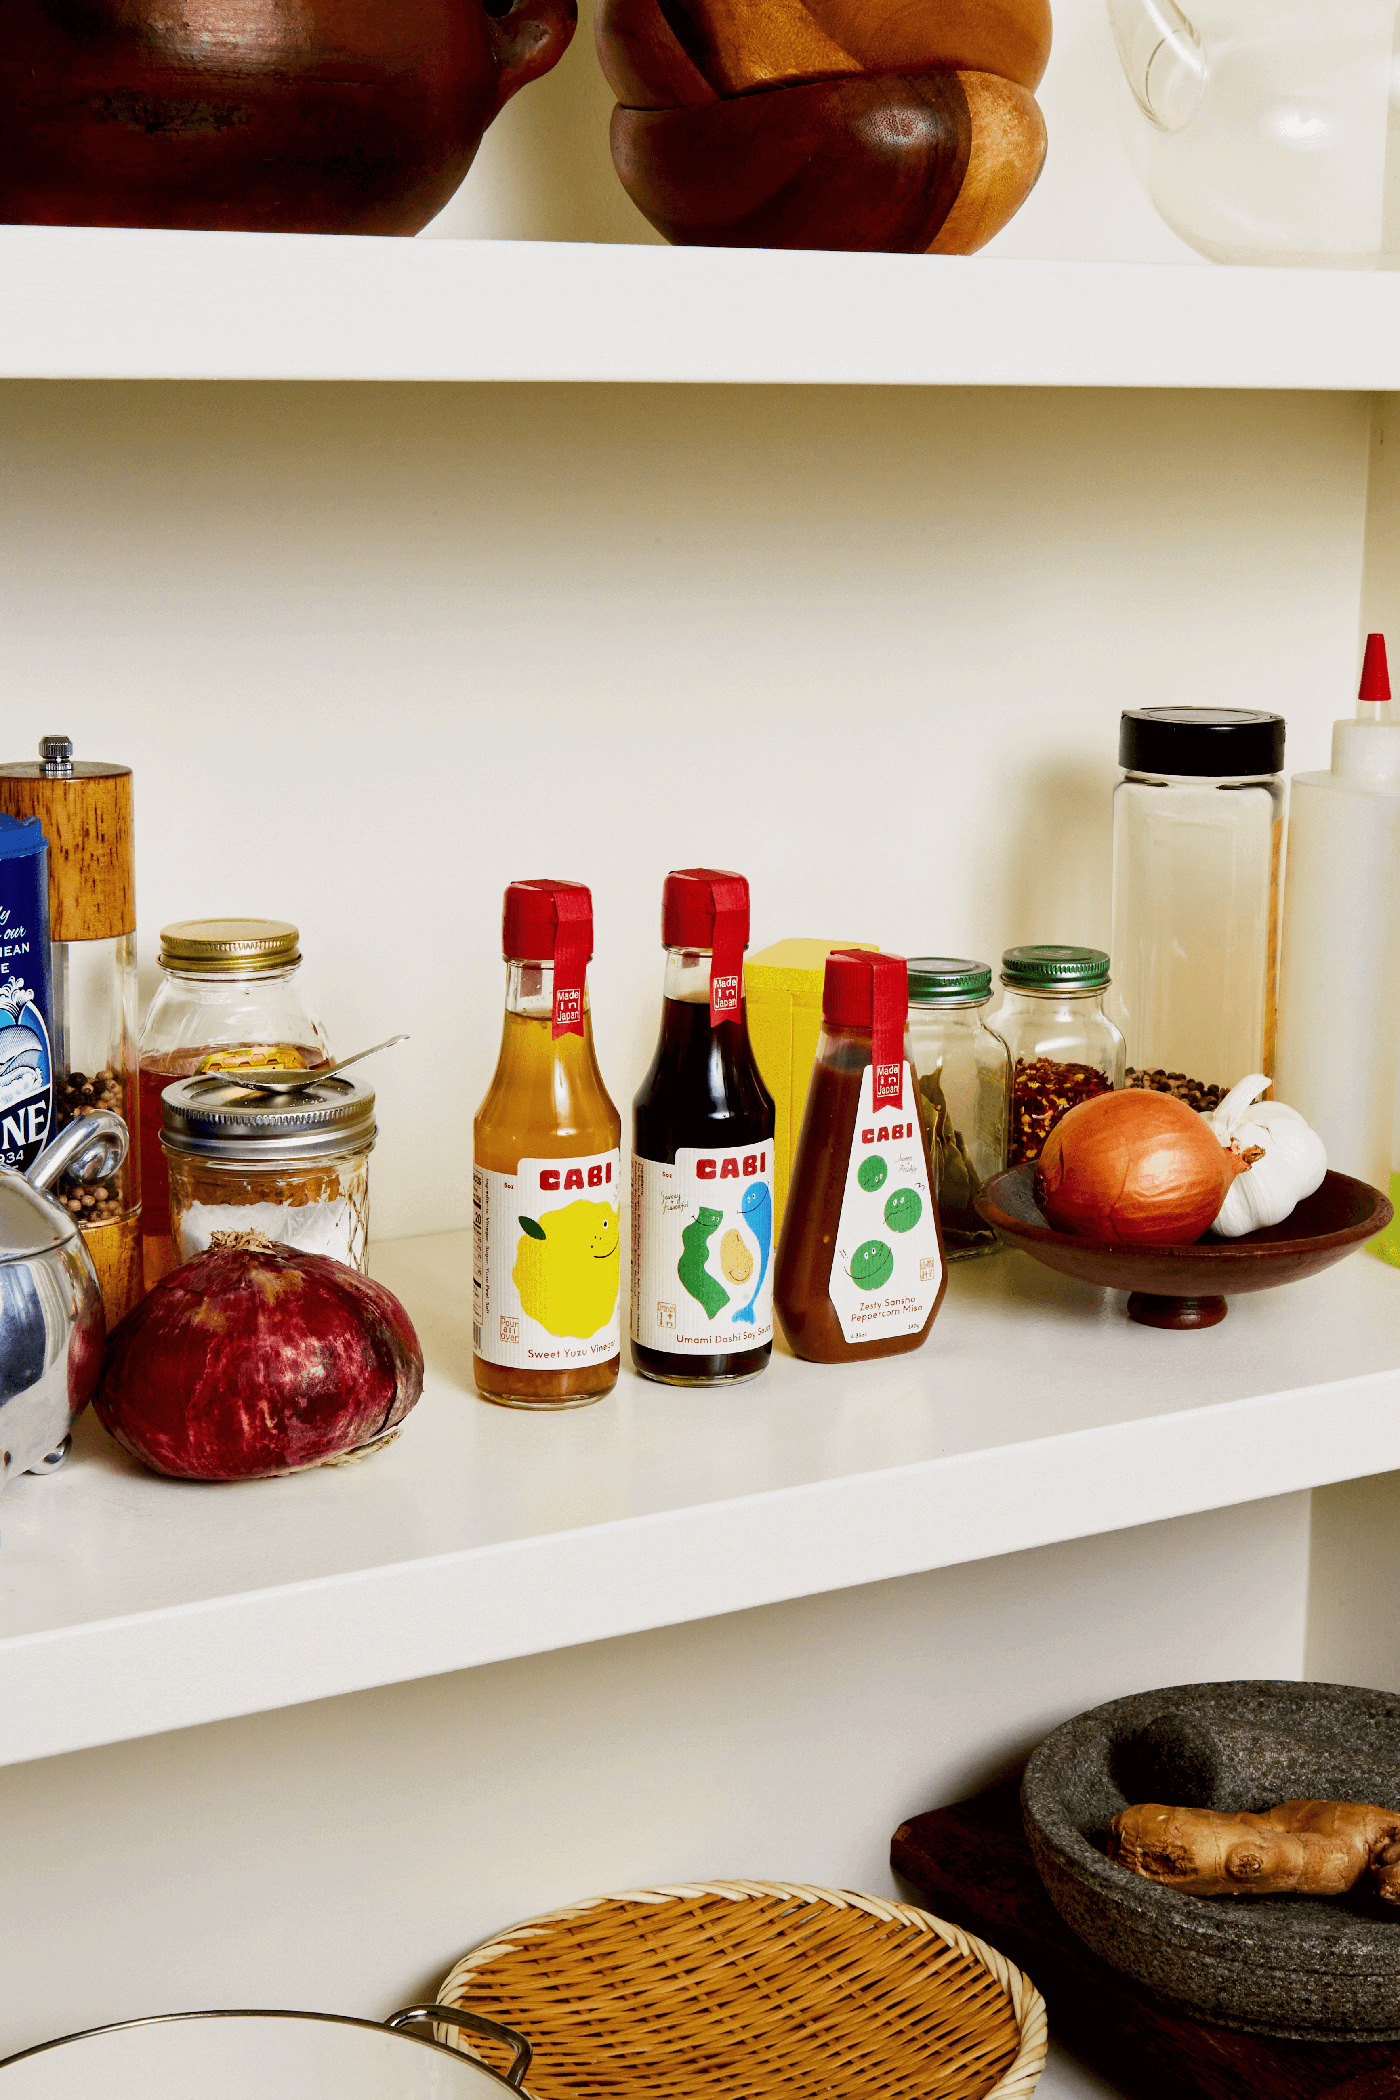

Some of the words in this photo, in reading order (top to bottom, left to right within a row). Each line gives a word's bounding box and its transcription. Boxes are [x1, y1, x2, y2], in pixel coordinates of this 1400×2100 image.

[3, 925, 27, 940] our
[713, 977, 737, 988] Made
[557, 989, 579, 1001] Made
[718, 989, 735, 997] in
[560, 1002, 577, 1010] in
[714, 998, 737, 1009] Japan
[557, 1011, 579, 1022] Japan
[877, 1065, 899, 1075] Made
[880, 1076, 896, 1084] in
[877, 1085, 899, 1095] Japan
[861, 1122, 913, 1144] CABI
[696, 1151, 766, 1180] CABI
[539, 1162, 612, 1191] CABI
[859, 1302, 882, 1312] Zesty
[884, 1295, 916, 1307] Sansho
[851, 1309, 900, 1323] Peppercorn
[902, 1304, 923, 1314] Miso
[500, 1317, 519, 1328] Pour
[676, 1334, 712, 1344] Umami
[715, 1333, 741, 1344] Dashi
[743, 1331, 756, 1341] Soy
[527, 1349, 560, 1359] Sweet
[563, 1349, 588, 1358] Yuzu
